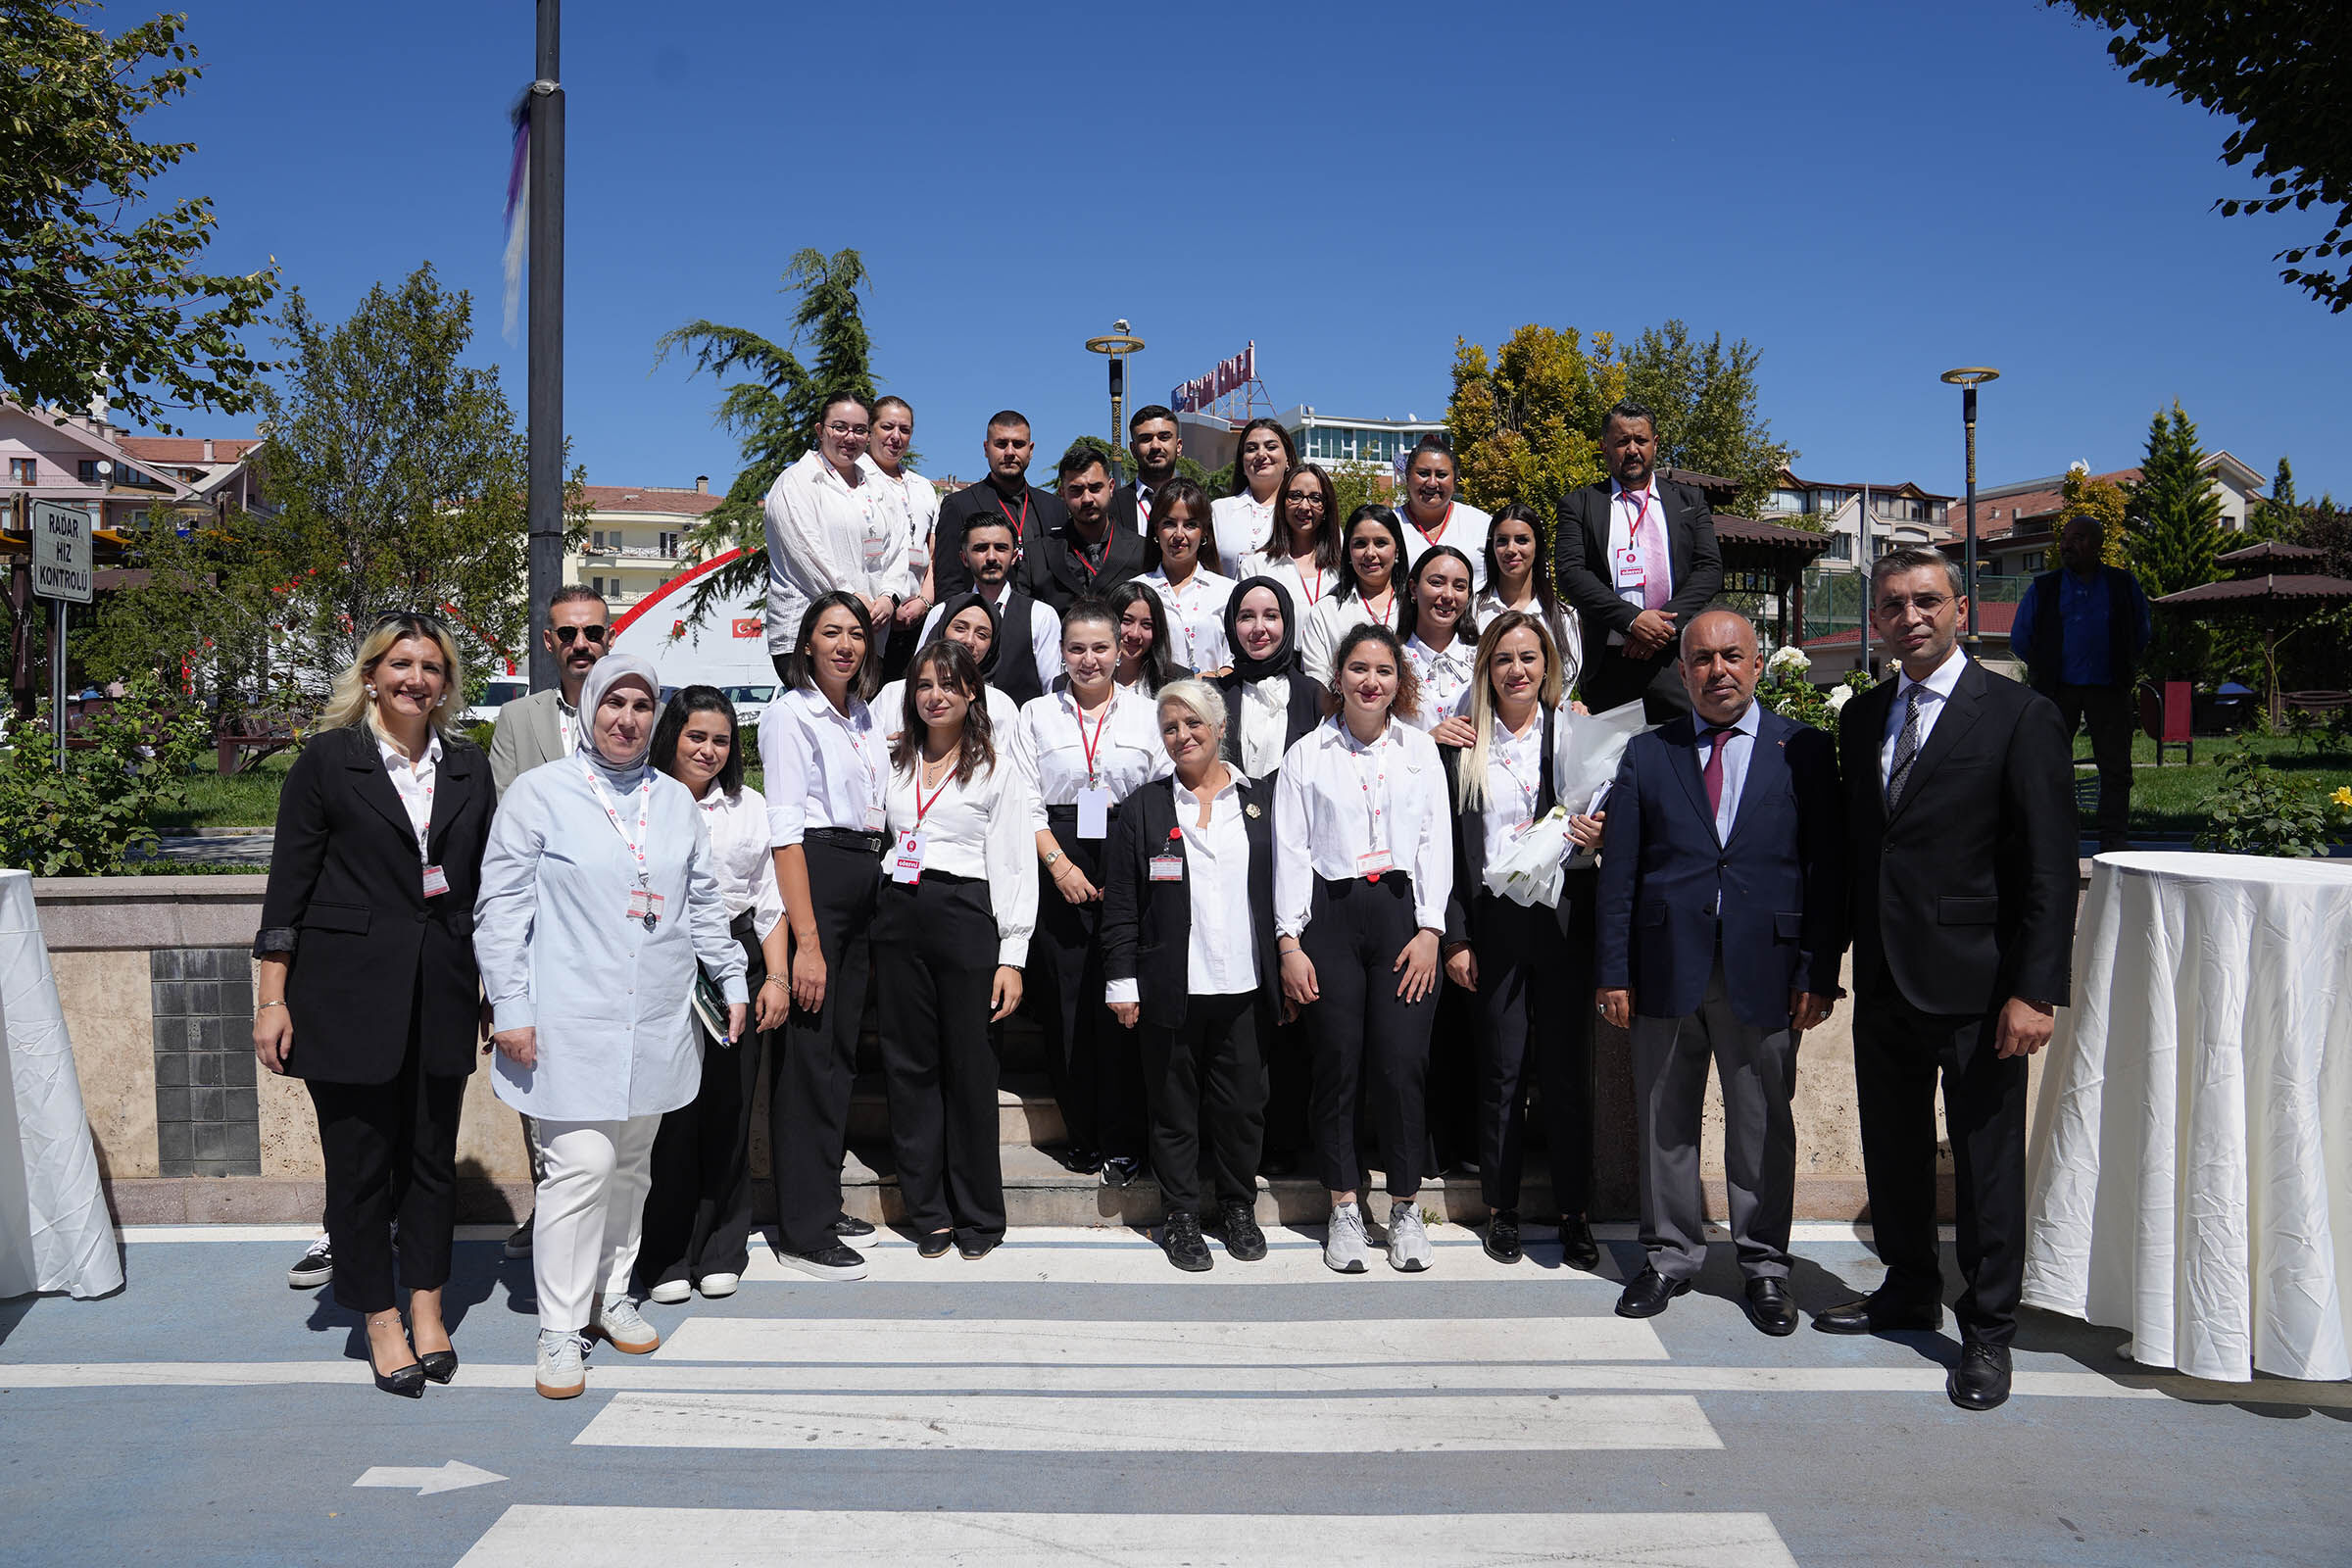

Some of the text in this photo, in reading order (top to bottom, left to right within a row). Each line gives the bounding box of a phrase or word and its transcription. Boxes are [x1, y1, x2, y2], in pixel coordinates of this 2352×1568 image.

[49, 514, 78, 538] RADAR
[56, 541, 72, 563] HIZ
[39, 565, 87, 592] KONTROLÜ
